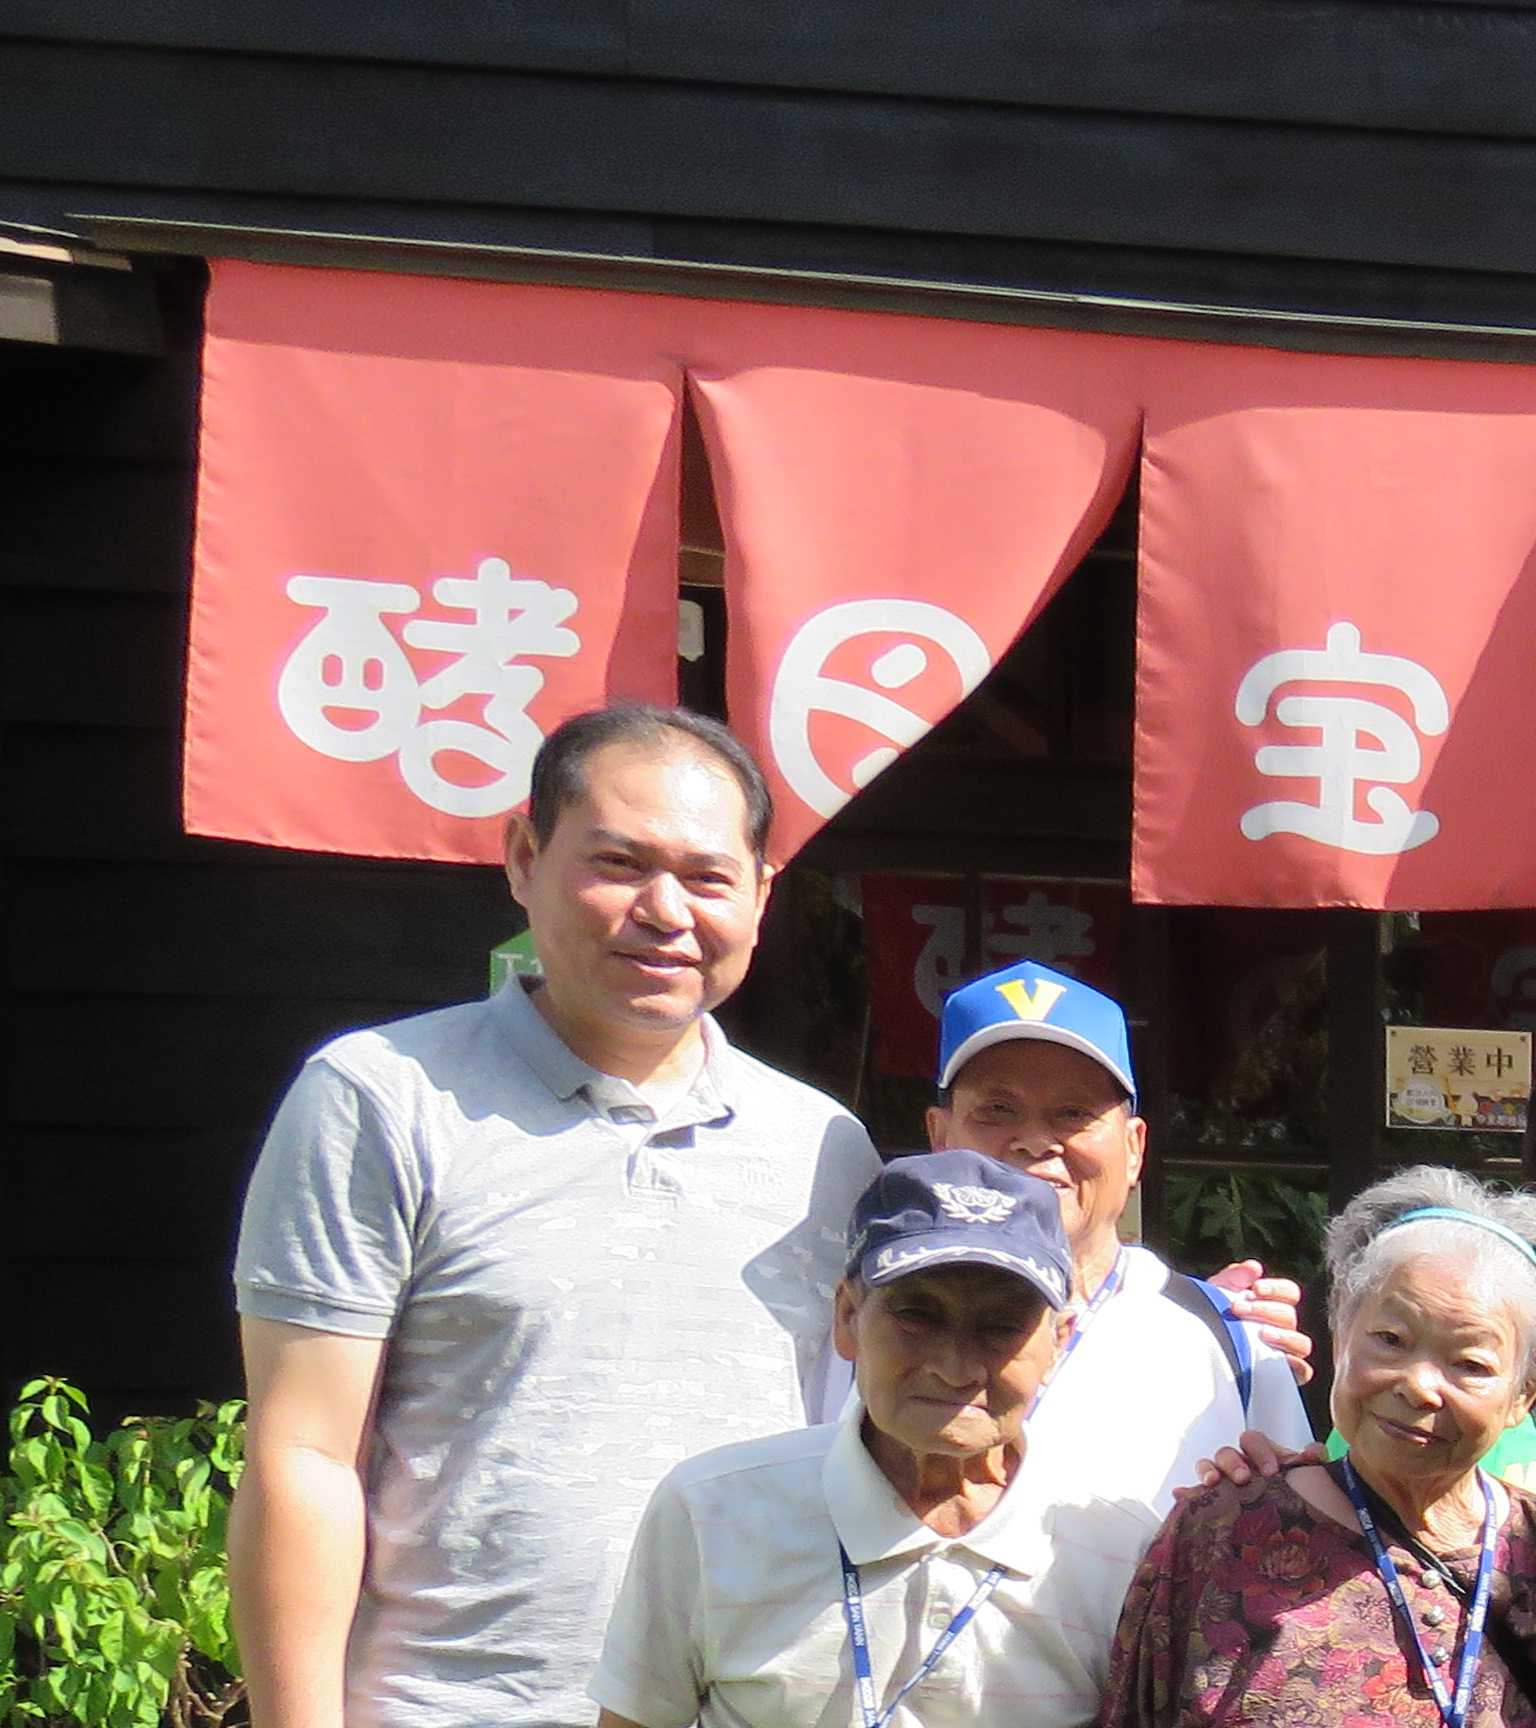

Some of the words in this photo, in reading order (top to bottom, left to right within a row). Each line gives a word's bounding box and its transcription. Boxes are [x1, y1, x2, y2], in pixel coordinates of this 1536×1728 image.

[995, 978, 1067, 1021] V
[1408, 1044, 1514, 1078] 營業中
